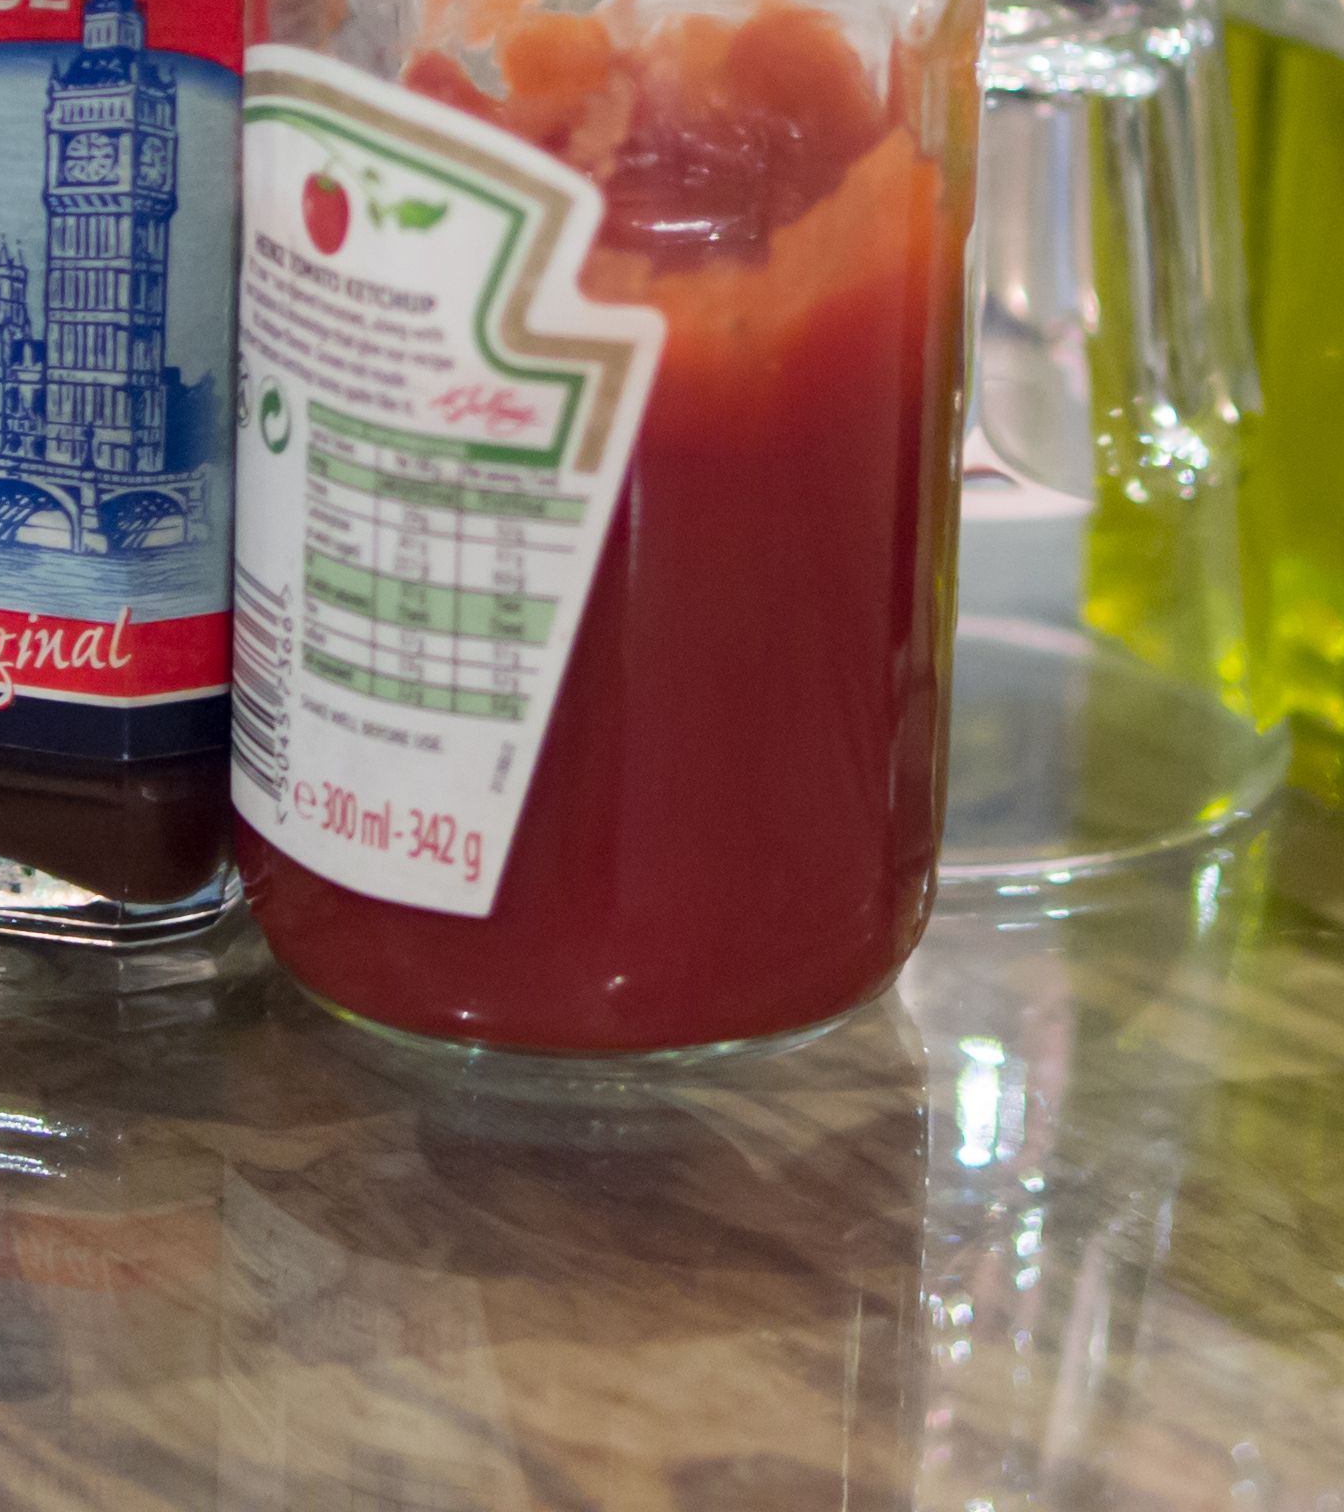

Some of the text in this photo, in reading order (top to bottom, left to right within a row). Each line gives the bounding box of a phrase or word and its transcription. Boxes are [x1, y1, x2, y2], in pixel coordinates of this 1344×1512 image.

[321, 780, 357, 840] 300
[407, 808, 457, 865] 342
[463, 830, 483, 884] g
